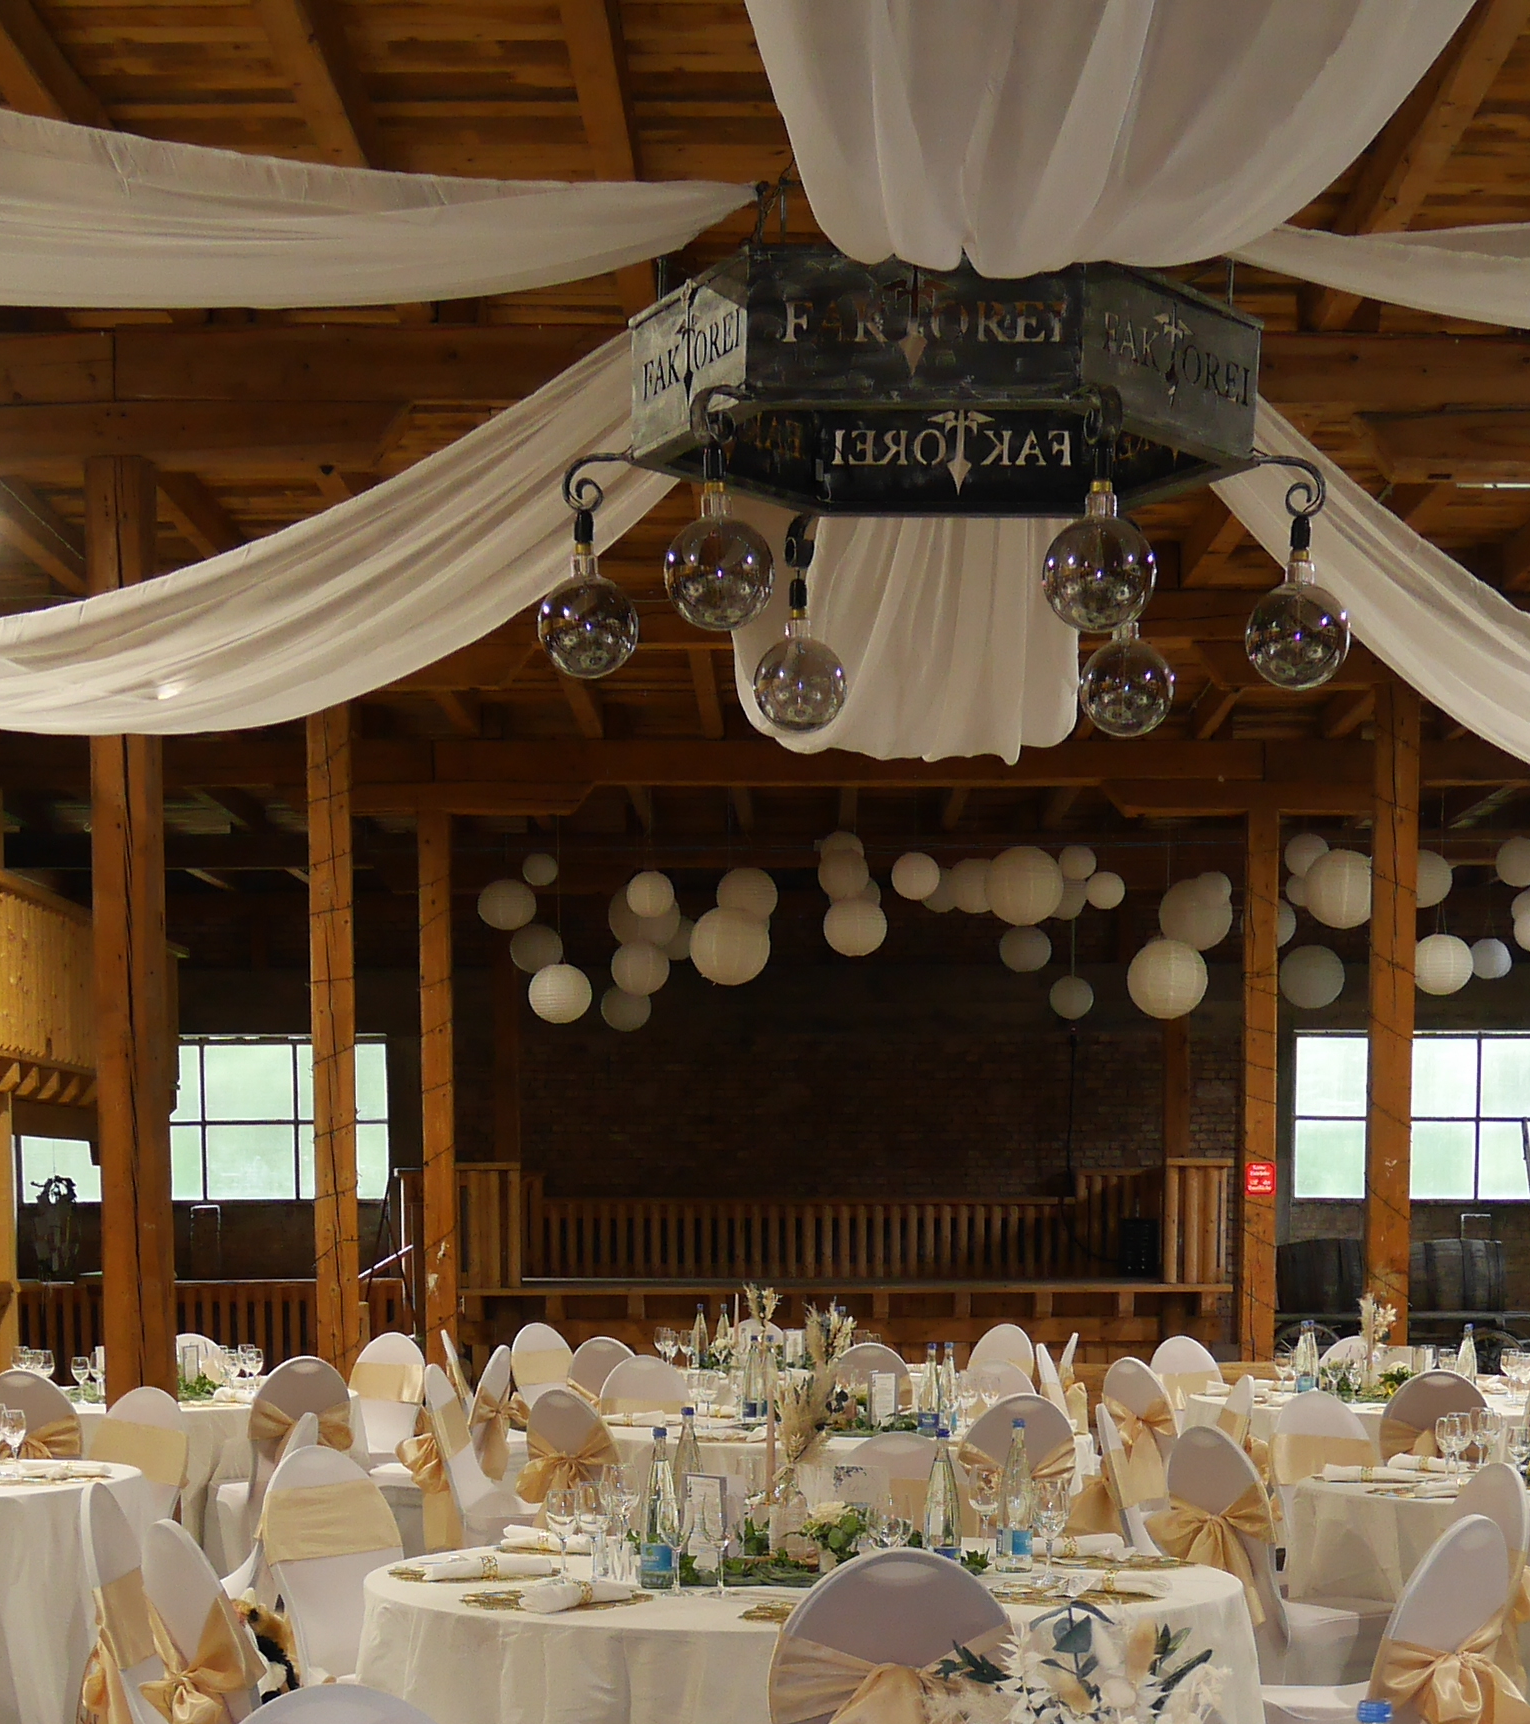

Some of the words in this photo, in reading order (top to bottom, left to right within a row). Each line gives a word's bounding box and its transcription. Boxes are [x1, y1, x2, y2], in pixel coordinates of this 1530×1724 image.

[643, 288, 741, 405] FAKTOREI
[781, 268, 1068, 376] FAKTOREI
[1103, 302, 1250, 407] FAKTOREI
